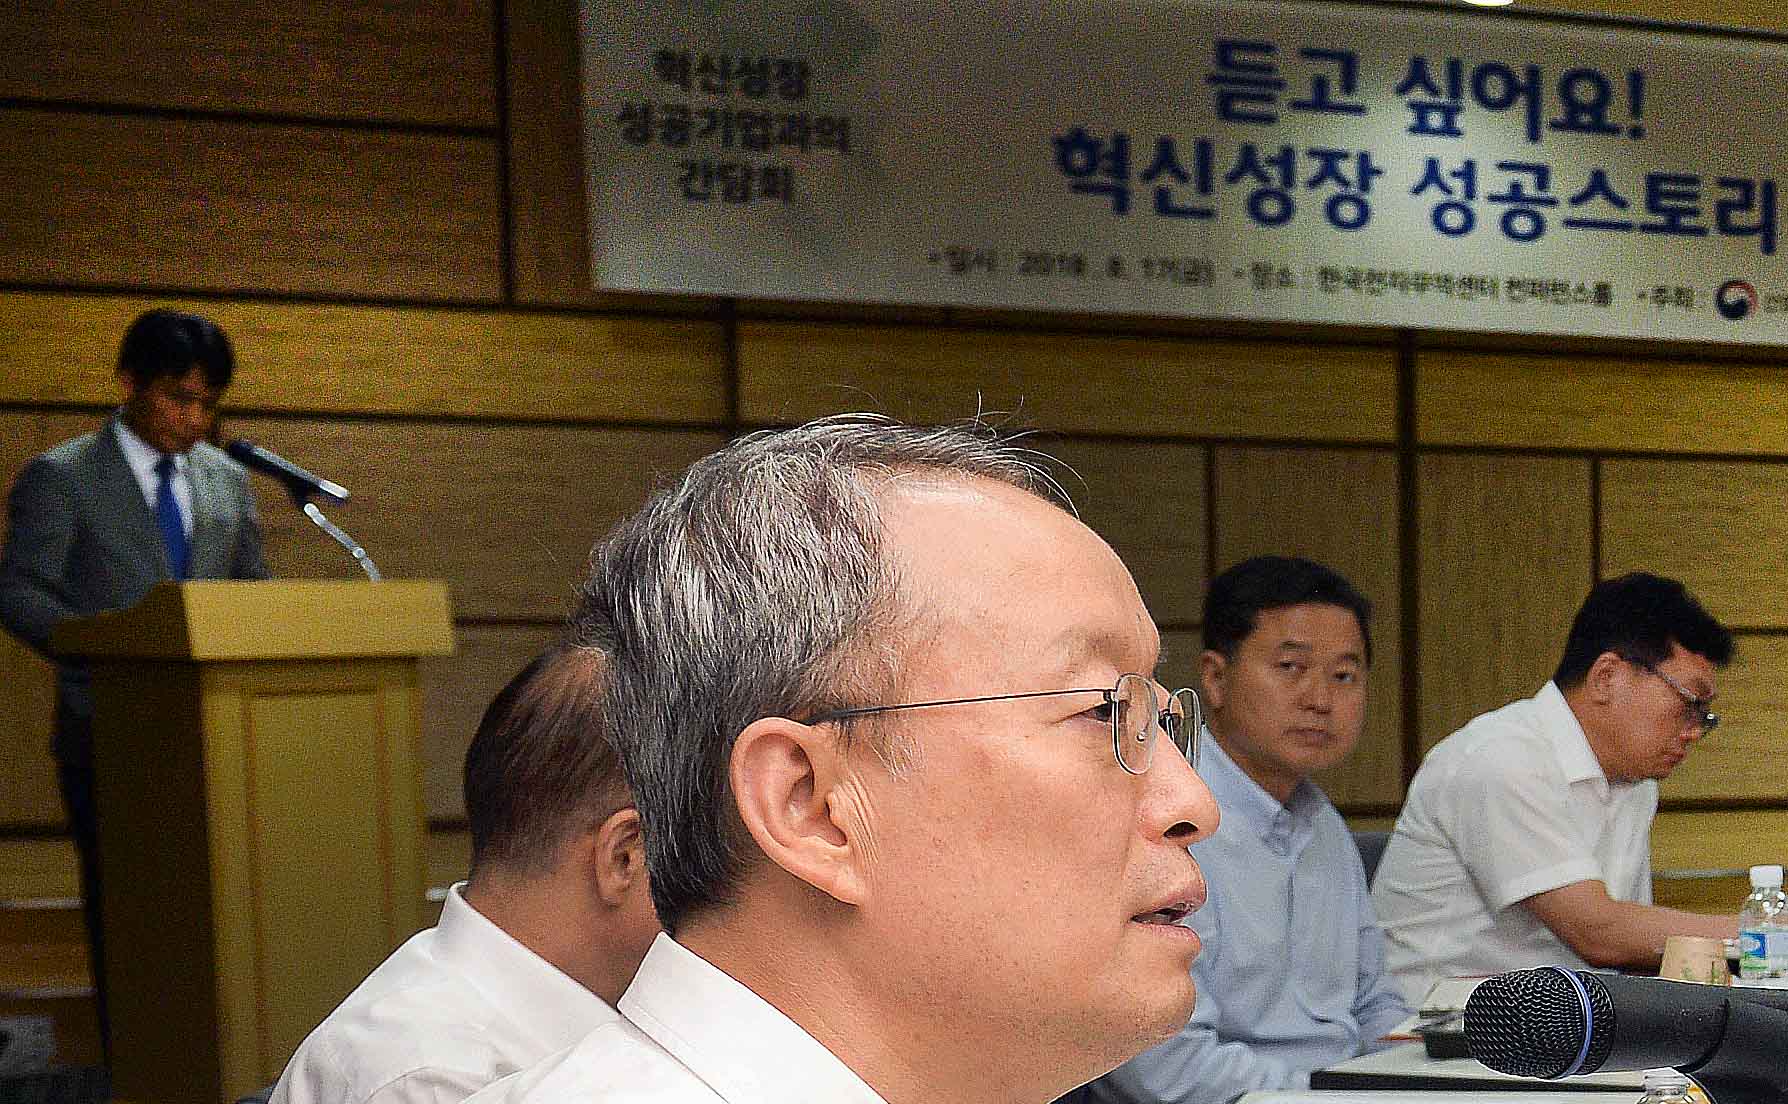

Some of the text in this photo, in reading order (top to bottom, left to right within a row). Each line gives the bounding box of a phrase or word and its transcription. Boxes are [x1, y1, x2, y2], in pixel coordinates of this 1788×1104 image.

[653, 48, 809, 100] 혁신성장
[1207, 38, 1647, 142] 듣고 싶어요!
[615, 102, 851, 154] 성공기업과의
[676, 160, 796, 203] 간담회
[1052, 127, 1778, 255] 혁신성장 성공스토리
